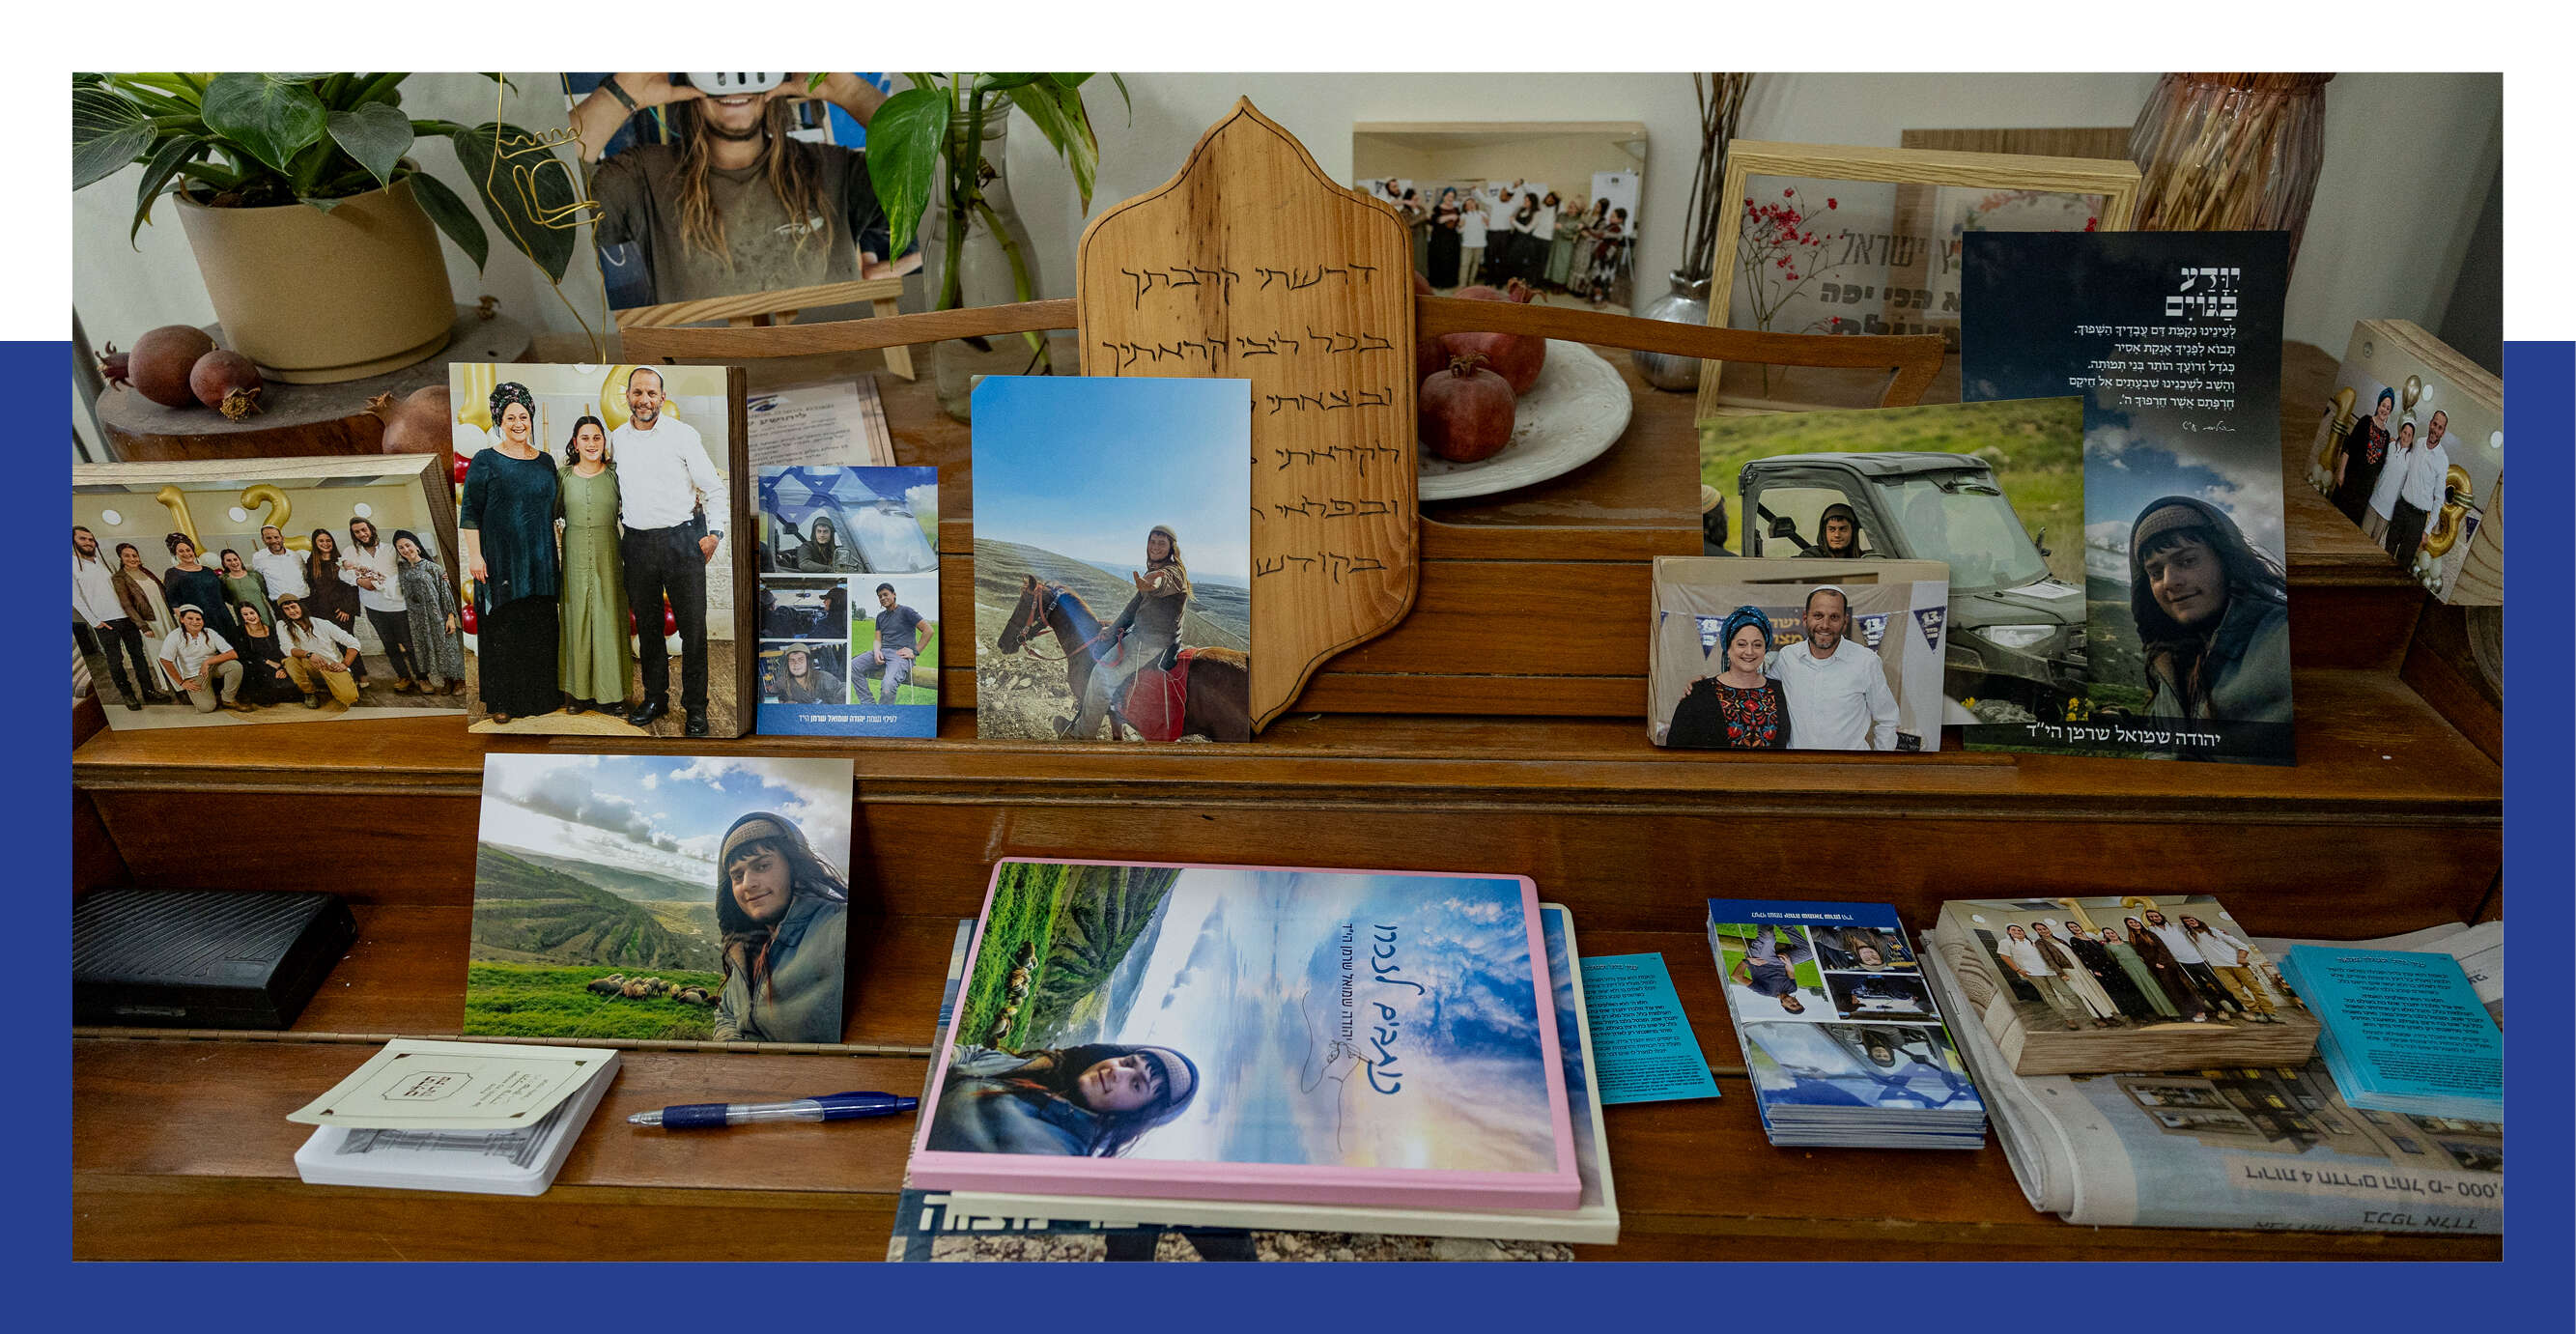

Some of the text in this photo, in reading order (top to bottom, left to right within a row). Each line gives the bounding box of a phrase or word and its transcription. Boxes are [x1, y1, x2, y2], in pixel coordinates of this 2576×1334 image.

[1255, 264, 1377, 291] דרשתי
[1820, 282, 1875, 304] יפה
[1883, 287, 1933, 310] הכי
[1306, 326, 1394, 354] בכל
[2067, 726, 2110, 743] שרמן
[2115, 724, 2170, 744] שמואל
[2175, 731, 2222, 748] יהודה
[1341, 946, 1353, 971] שרמן
[1372, 923, 1426, 997] לזכרו
[1342, 974, 1354, 1008] שמואל
[1342, 1010, 1353, 1041] יהודה
[2244, 1164, 2298, 1183] דירות
[2302, 1171, 2313, 1184] 4
[2317, 1171, 2378, 1189] חדרים
[2383, 1176, 2425, 1196] החל
[2458, 1181, 2504, 1200] ,000
[2363, 1210, 2416, 1228] בכפר
[2424, 1214, 2477, 1231] אלדד
